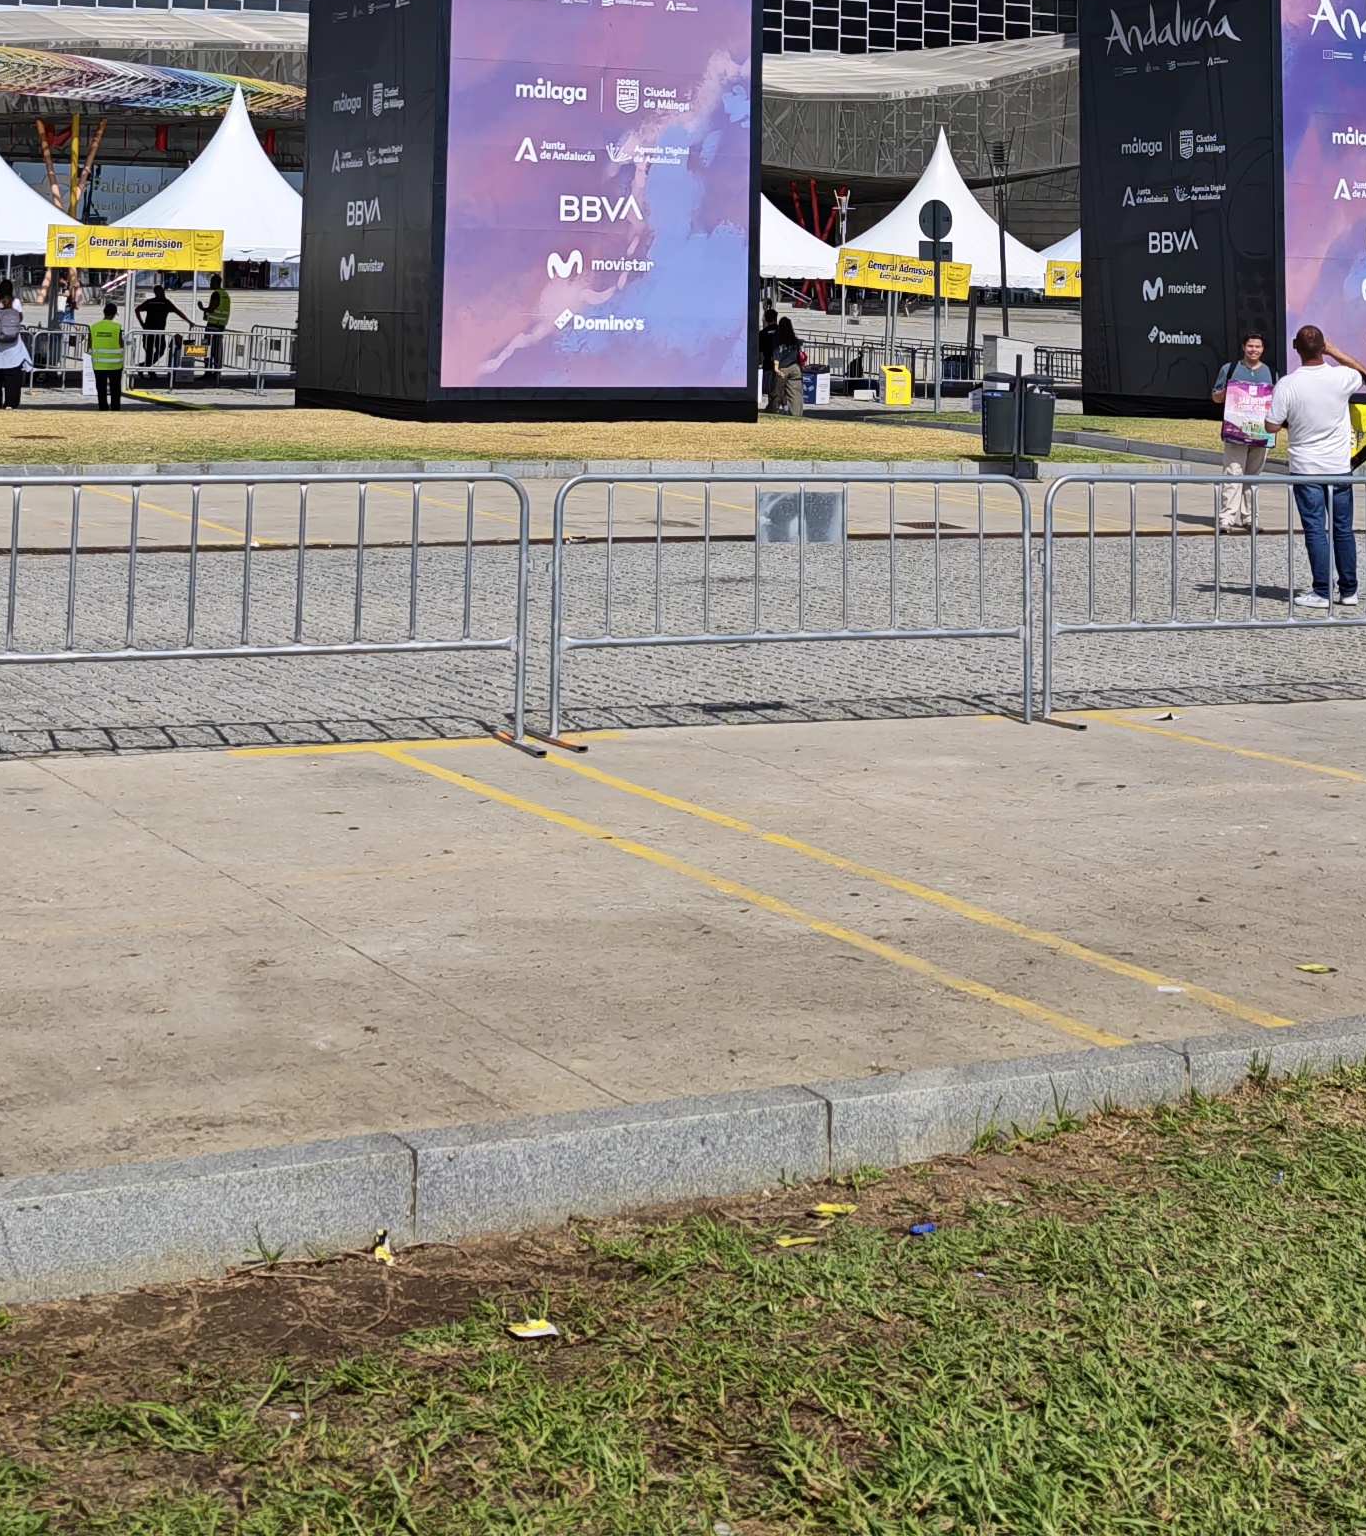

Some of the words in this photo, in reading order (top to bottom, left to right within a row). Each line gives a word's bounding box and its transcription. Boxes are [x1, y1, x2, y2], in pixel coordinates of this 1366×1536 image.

[643, 86, 677, 98] Ciudad
[643, 99, 656, 109] de
[657, 99, 690, 112] Málaga
[540, 140, 566, 151] Junta
[665, 146, 690, 156] Digital
[540, 150, 551, 160] de
[552, 150, 596, 162] Andalucía
[346, 195, 381, 227] BBVA
[559, 194, 644, 223] BBVA
[89, 235, 129, 247] General
[132, 236, 183, 249] Admission
[1148, 227, 1199, 254] BBVA
[591, 257, 655, 272] movistar
[898, 263, 935, 277] Admissio
[1168, 282, 1207, 295] movistar
[573, 314, 646, 331] Domino's
[1158, 330, 1202, 345] Domino's
